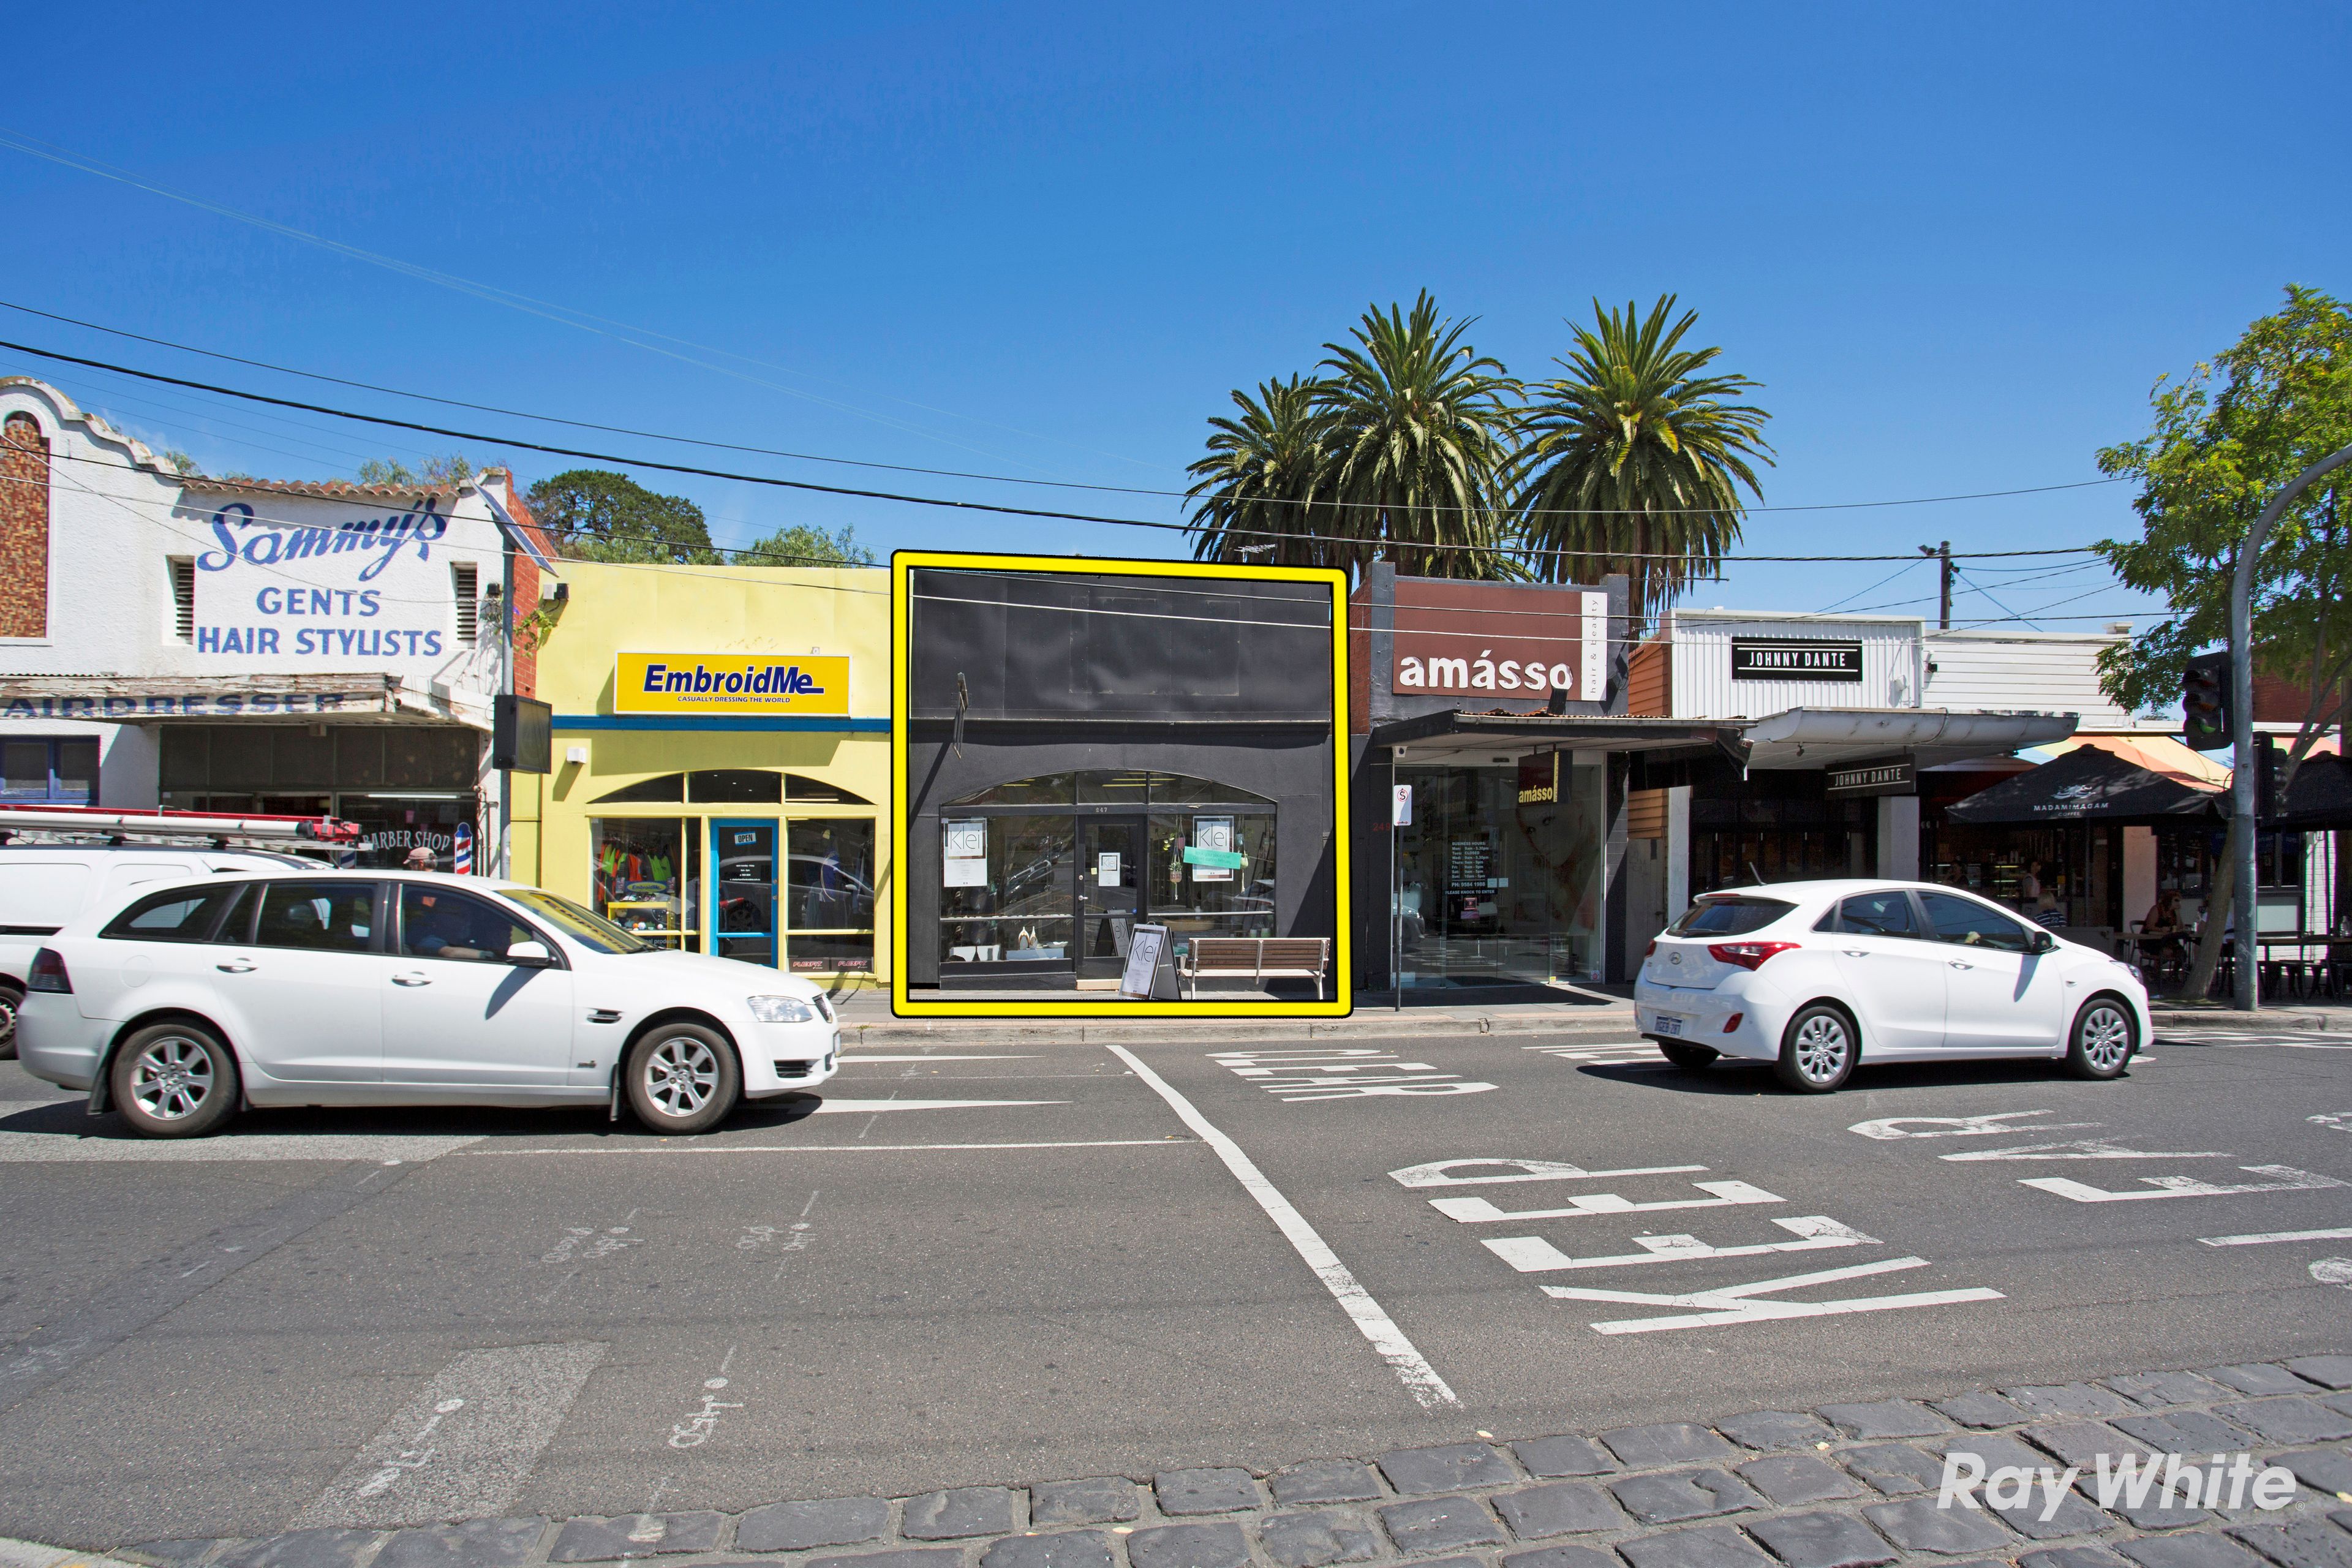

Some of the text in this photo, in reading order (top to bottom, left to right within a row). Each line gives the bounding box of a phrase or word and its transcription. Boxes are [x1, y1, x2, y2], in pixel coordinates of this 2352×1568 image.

[197, 497, 447, 582] Sammy's
[256, 587, 381, 617] GENTS
[198, 627, 442, 657] HAIR STYLISTS
[1399, 649, 1573, 690] amásso
[1749, 652, 1845, 667] JOHNNY DANTE
[643, 664, 824, 695] EmbroidMe
[1834, 768, 1901, 786] JOHNNY DANTE
[1518, 785, 1553, 804] amásso
[363, 830, 450, 851] BARBER SHOP
[737, 834, 753, 843] OPEN
[950, 825, 980, 850] Klei
[1199, 823, 1227, 846] Klei
[1102, 857, 1115, 868] Klei
[1132, 935, 1159, 962] Klei
[1205, 1049, 1499, 1102] CLEAR
[1387, 1158, 2007, 1335] KEEP
